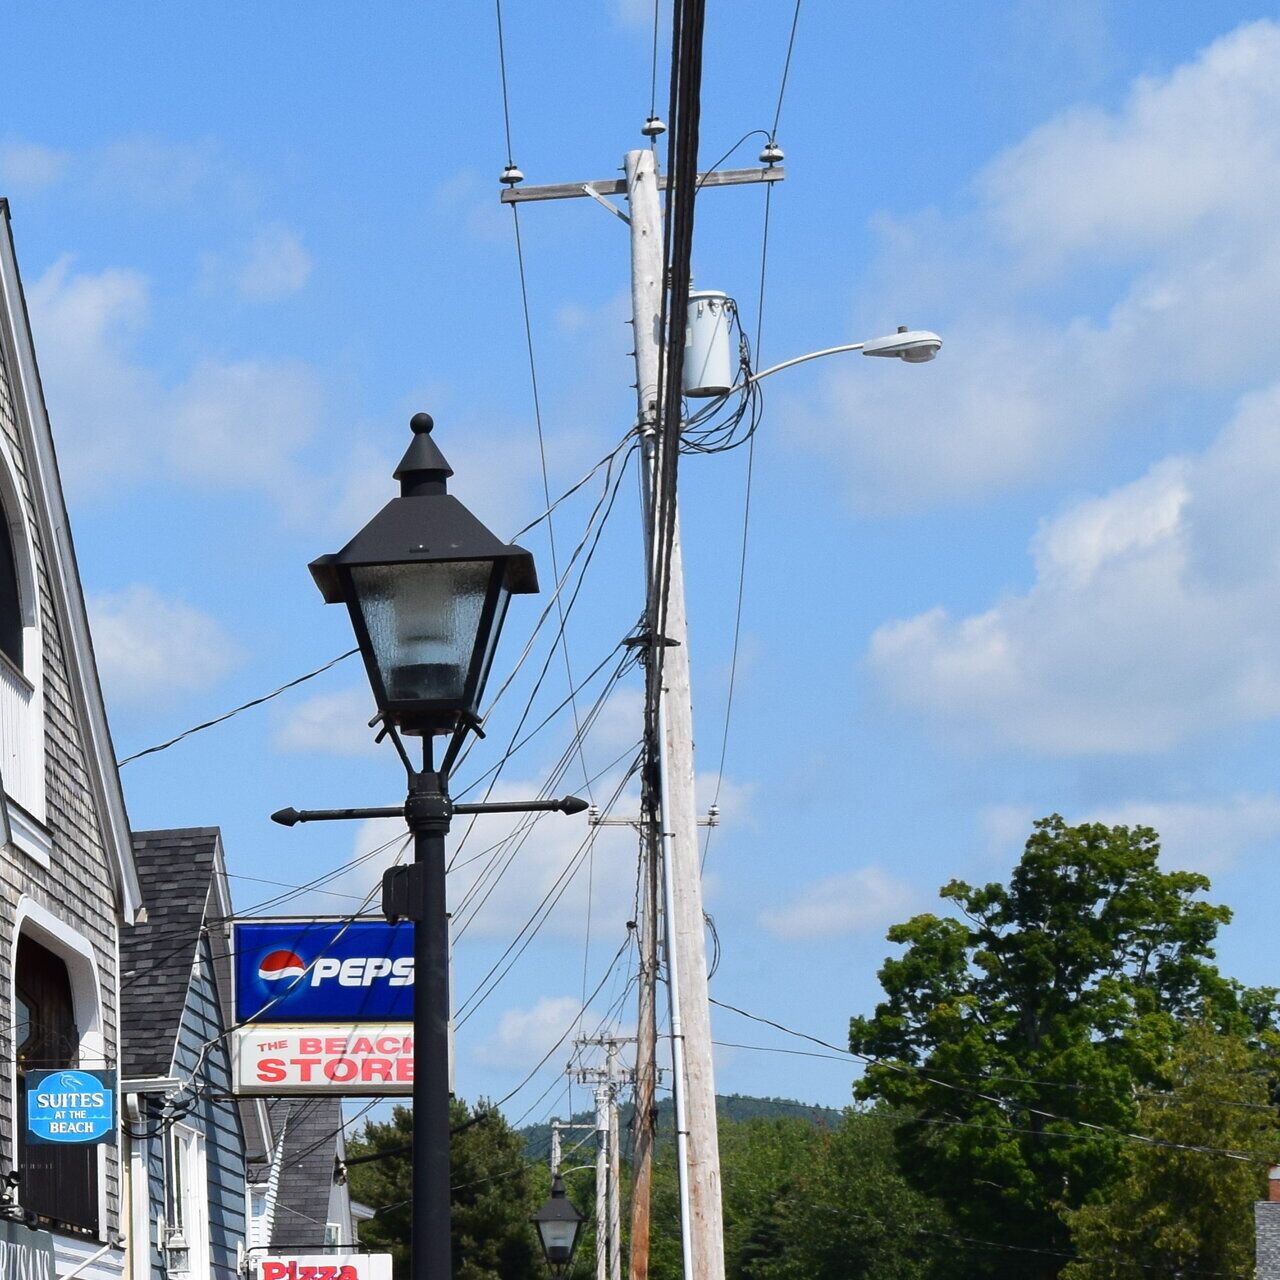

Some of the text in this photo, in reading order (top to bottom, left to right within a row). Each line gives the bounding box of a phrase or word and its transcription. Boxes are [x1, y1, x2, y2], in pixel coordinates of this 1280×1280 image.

[310, 957, 414, 987] PEPS
[256, 1040, 288, 1052] THE
[37, 1092, 104, 1109] SUITES
[54, 1110, 87, 1119] AT THE
[49, 1122, 94, 1134] BEACH
